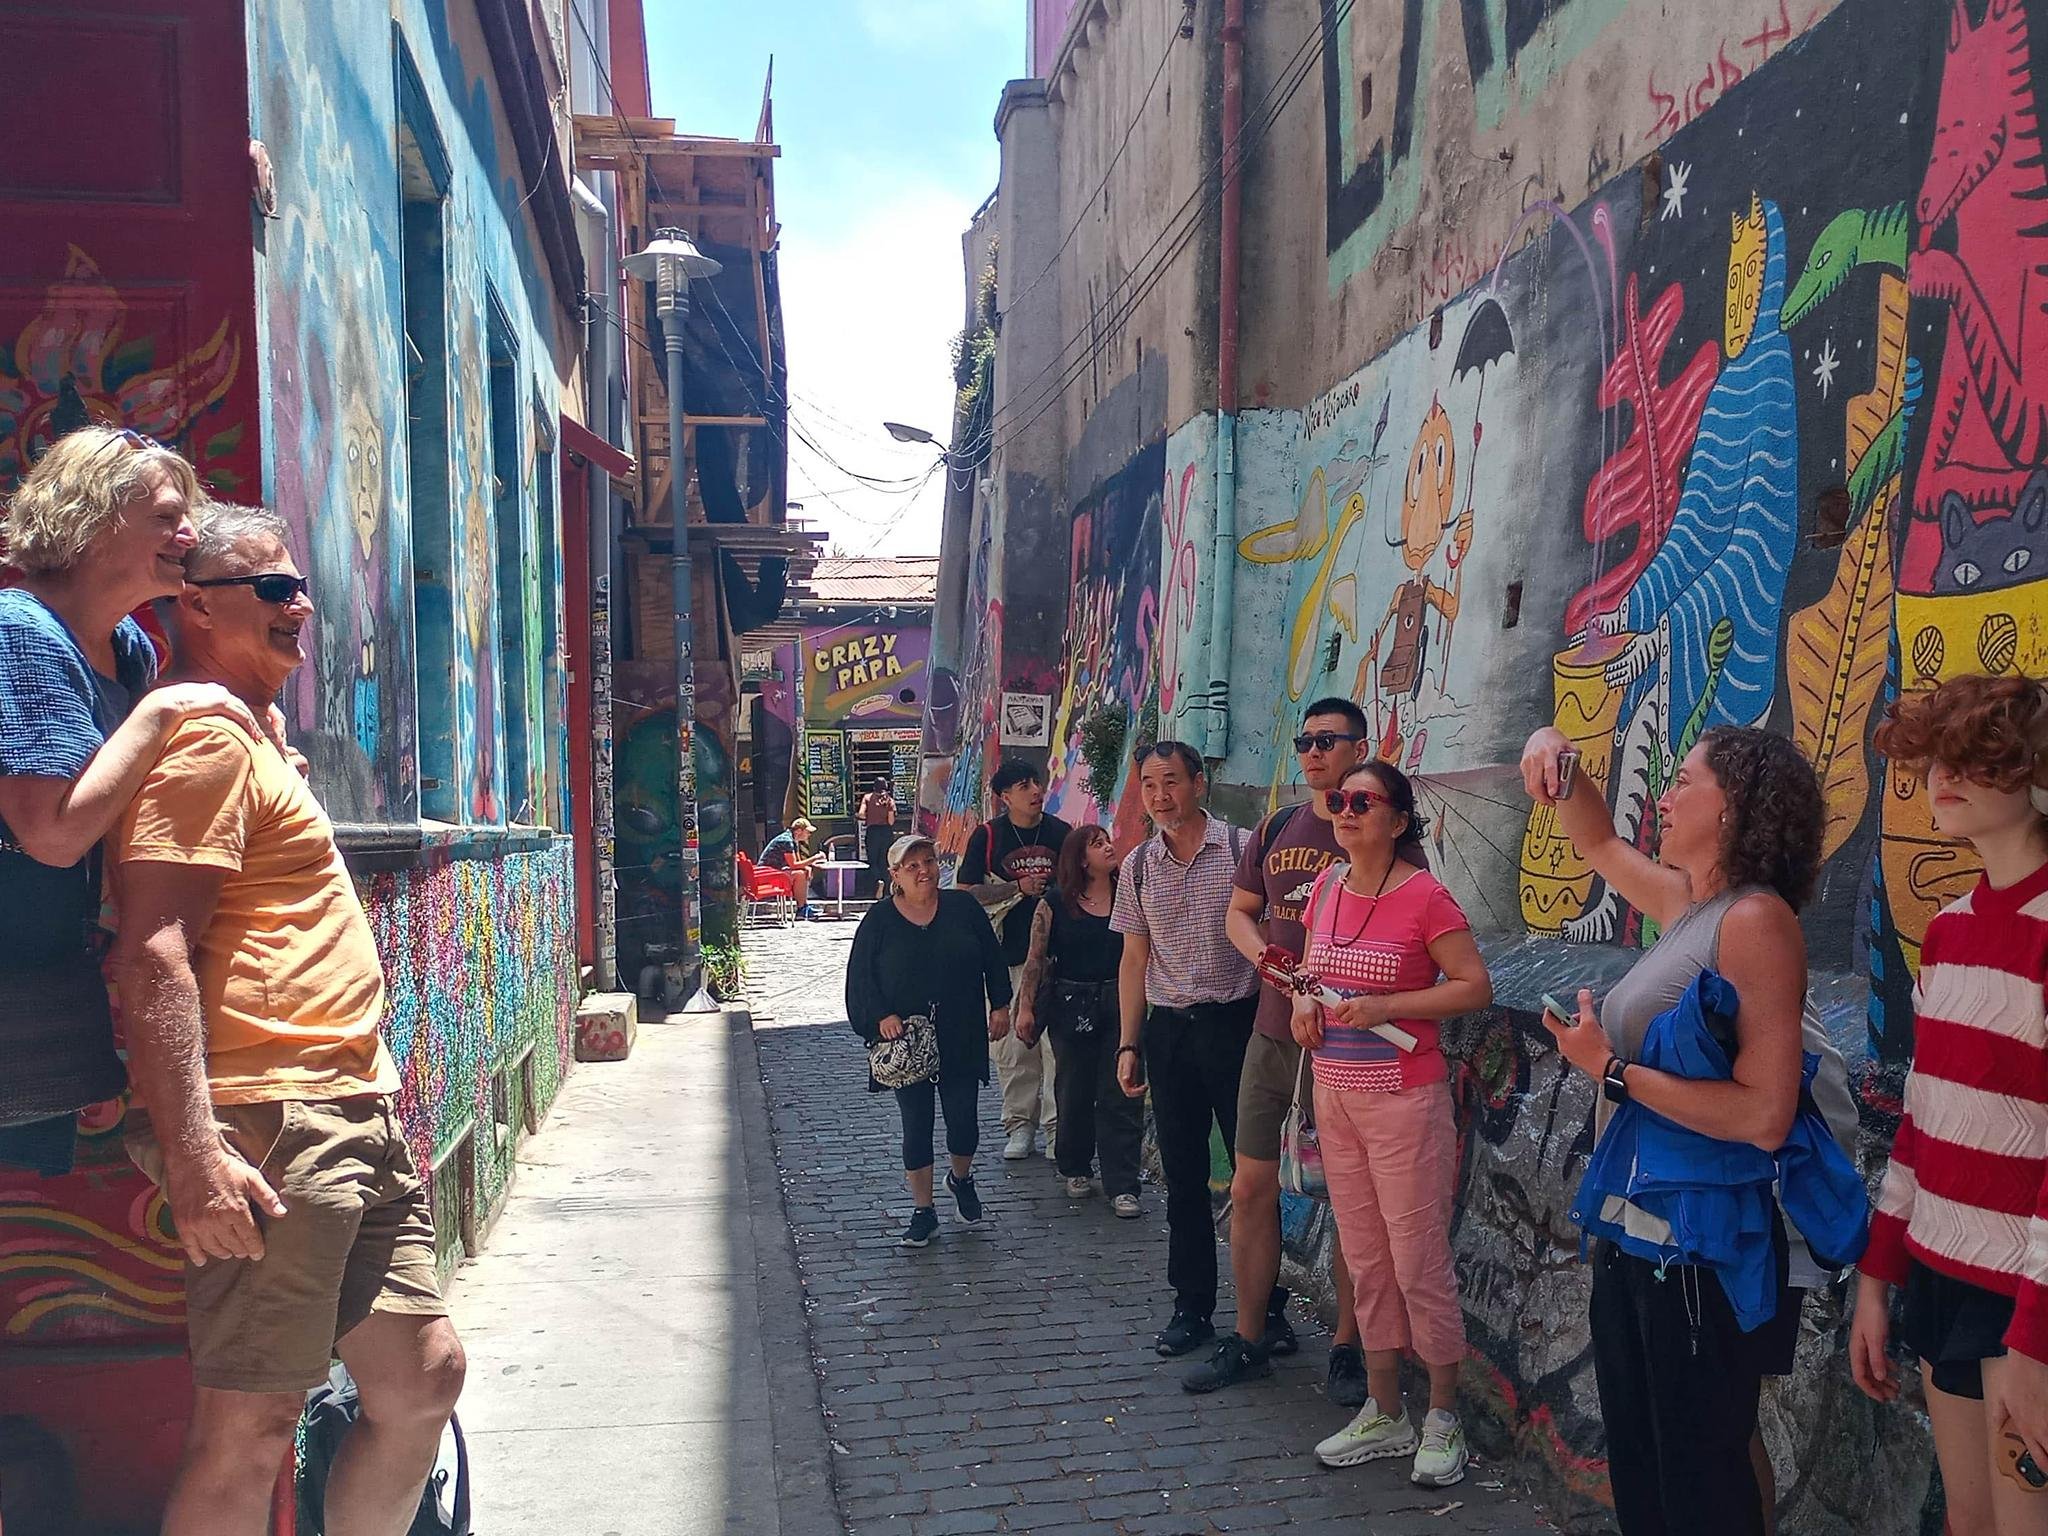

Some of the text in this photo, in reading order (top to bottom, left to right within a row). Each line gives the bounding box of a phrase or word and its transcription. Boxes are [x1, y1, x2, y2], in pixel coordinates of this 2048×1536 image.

[814, 634, 898, 673] CRAZY
[837, 655, 903, 690] PAPA
[739, 757, 752, 774] 4
[1268, 847, 1345, 875] CHICA
[1273, 905, 1297, 921] TRACK
